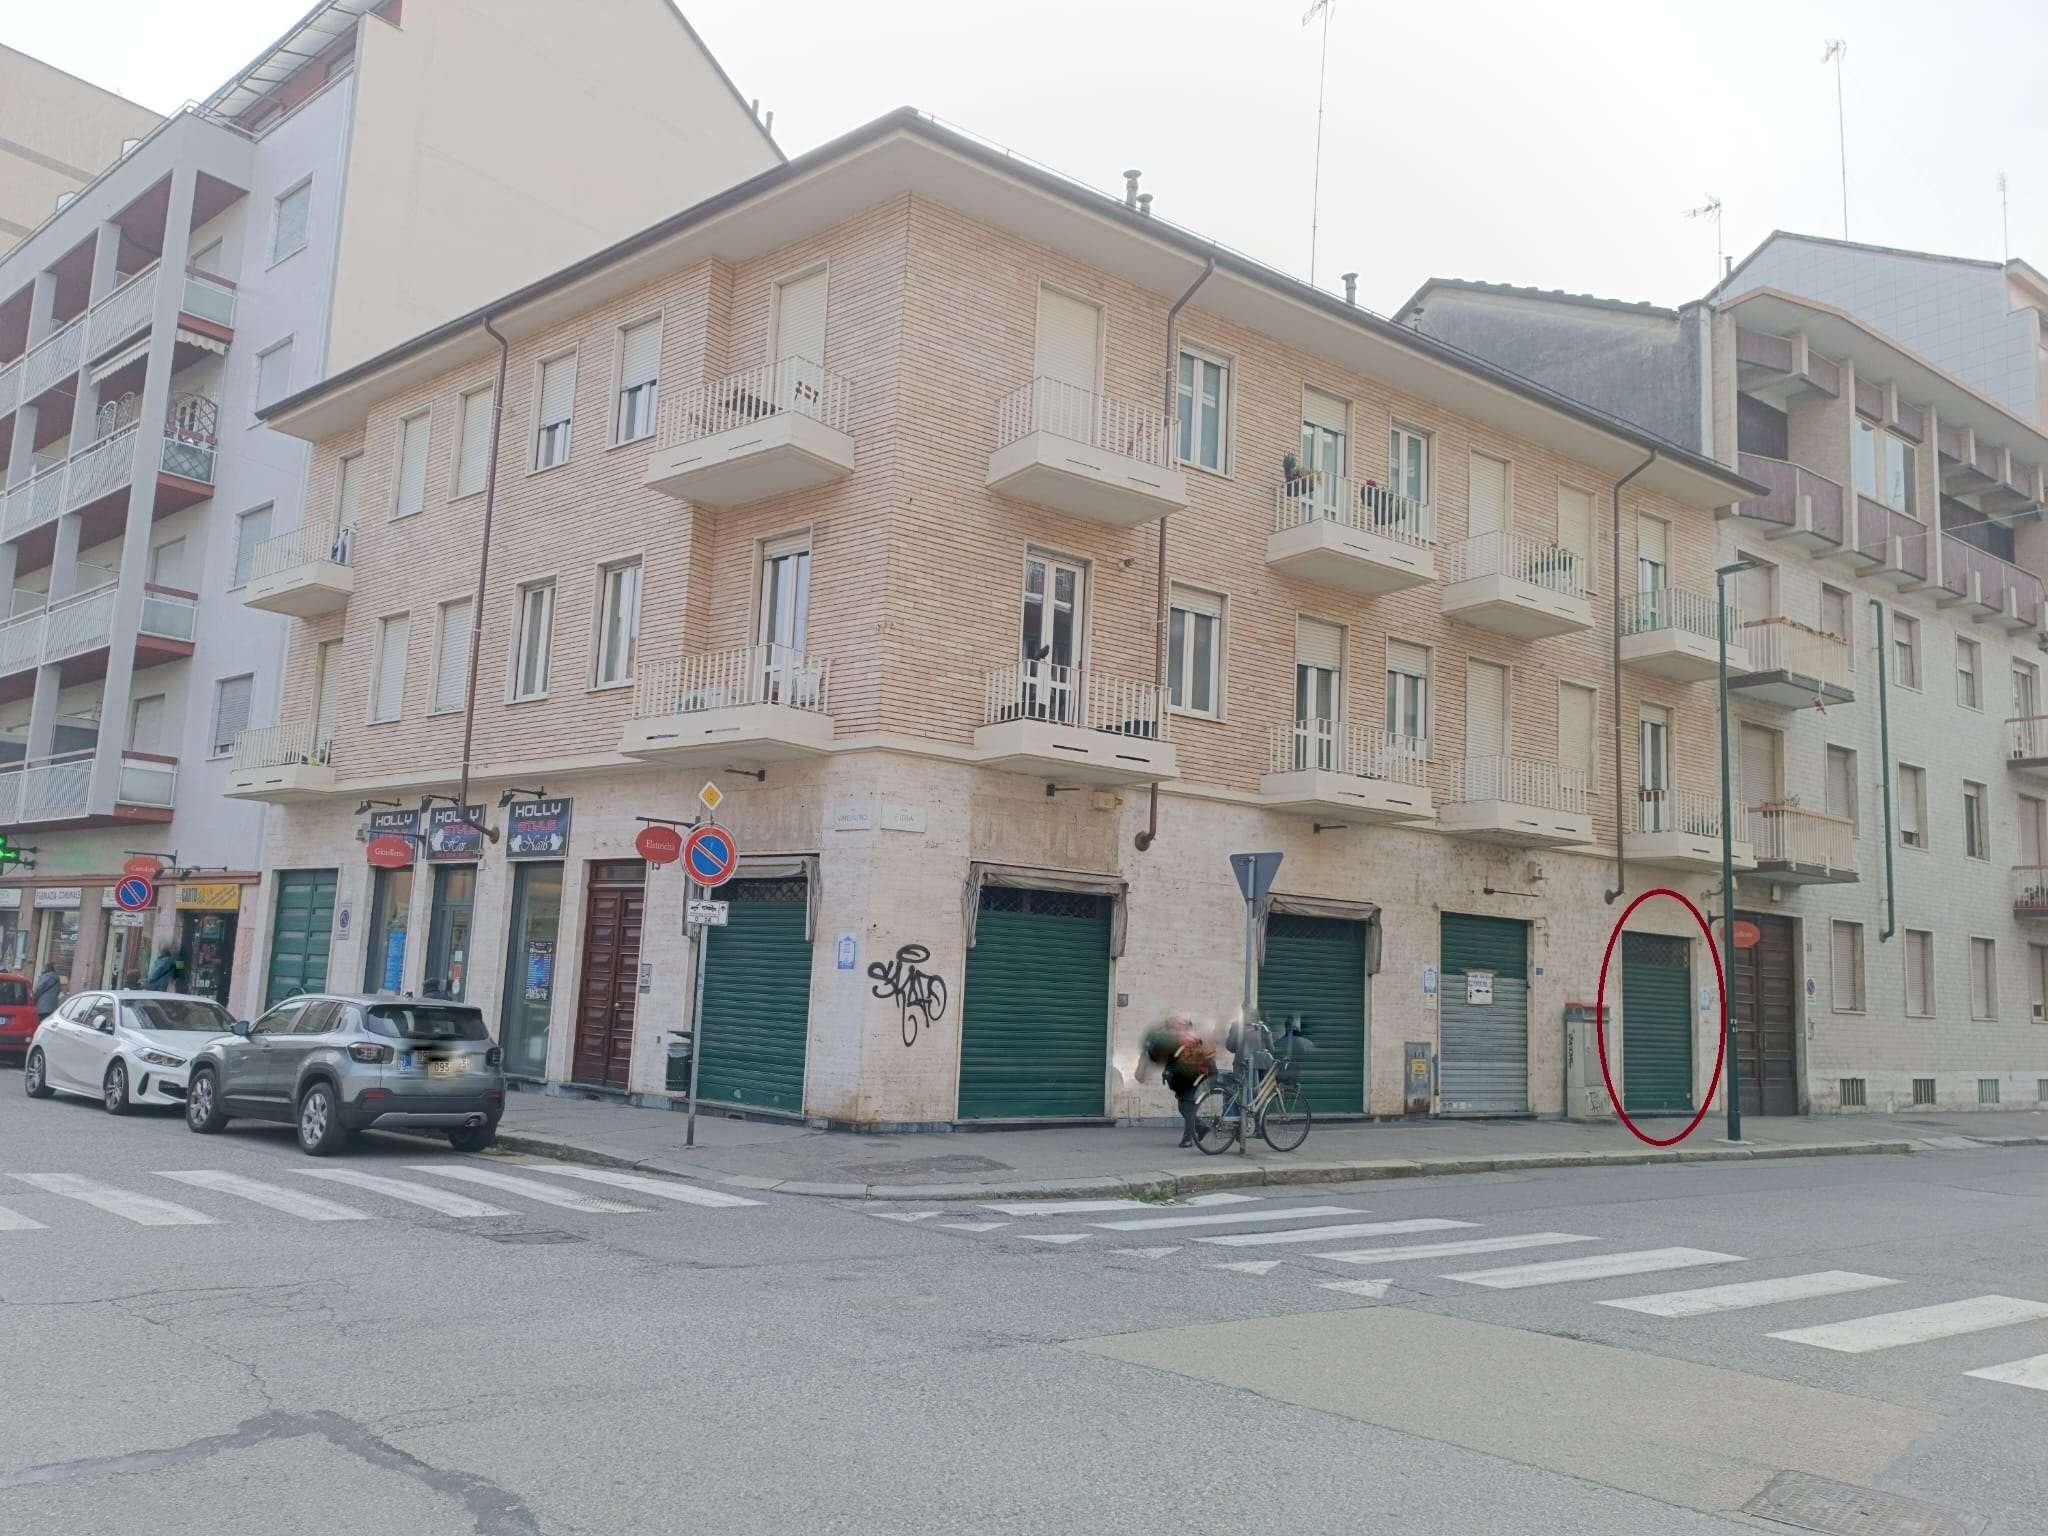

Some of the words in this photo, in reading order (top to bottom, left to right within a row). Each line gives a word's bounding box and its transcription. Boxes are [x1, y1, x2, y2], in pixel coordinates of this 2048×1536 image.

[436, 809, 480, 822] HOLY
[515, 803, 561, 817] HOLLY
[376, 813, 413, 826] HOLLY
